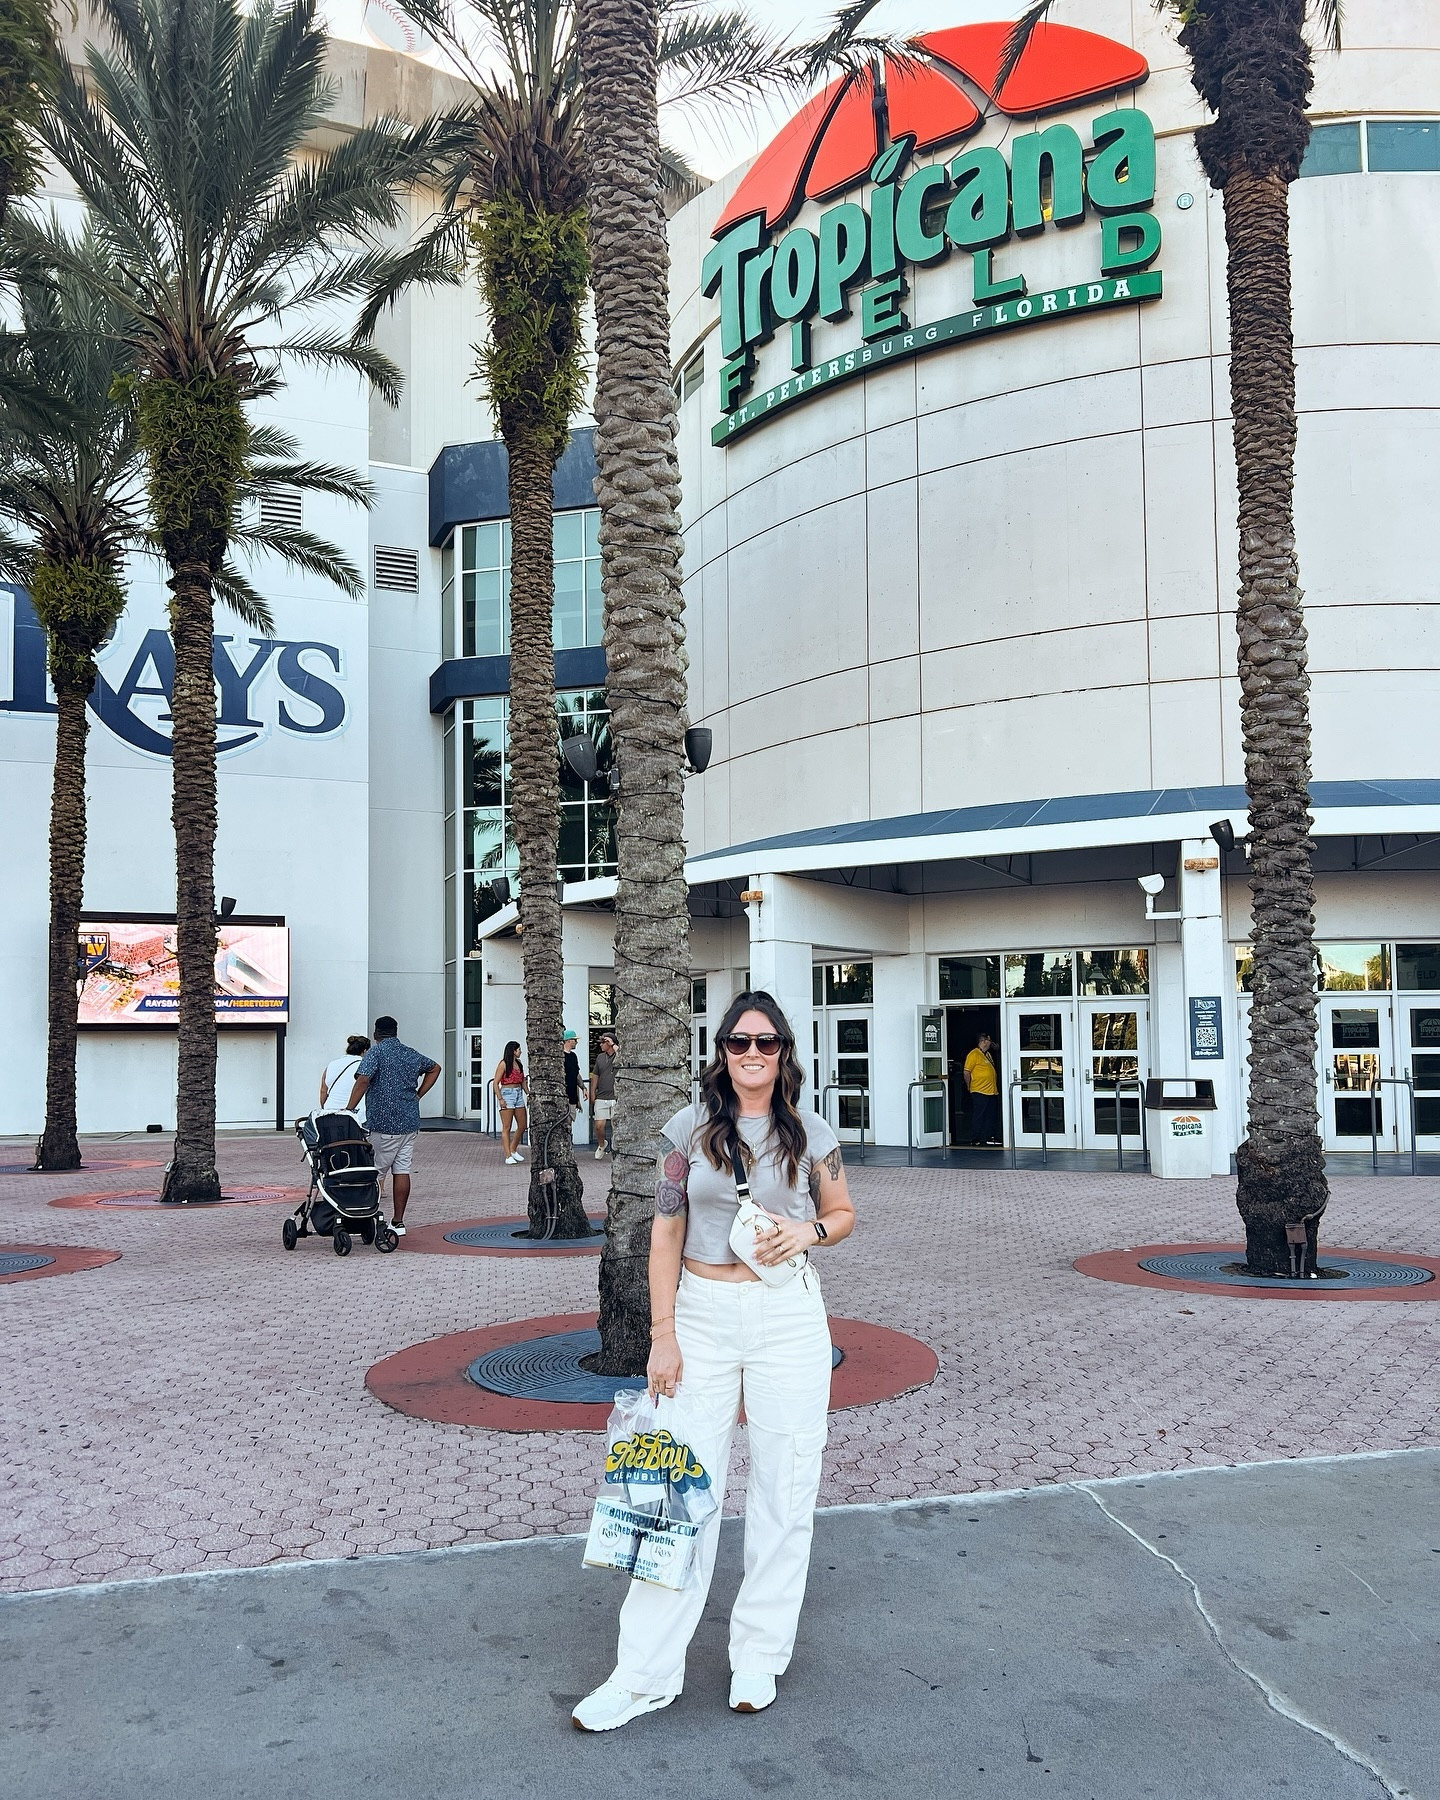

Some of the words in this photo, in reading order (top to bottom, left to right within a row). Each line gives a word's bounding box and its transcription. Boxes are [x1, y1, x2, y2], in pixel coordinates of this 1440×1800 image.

[701, 108, 1156, 360] Tropicana
[719, 212, 1163, 414] FIELD
[728, 406, 756, 432] ST.
[972, 279, 1131, 328] FLORIDA
[94, 935, 106, 943] TO
[1419, 1023, 1440, 1034] Tropica
[1171, 1122, 1202, 1131] Tropicana
[612, 1471, 668, 1481] REPUBLIC
